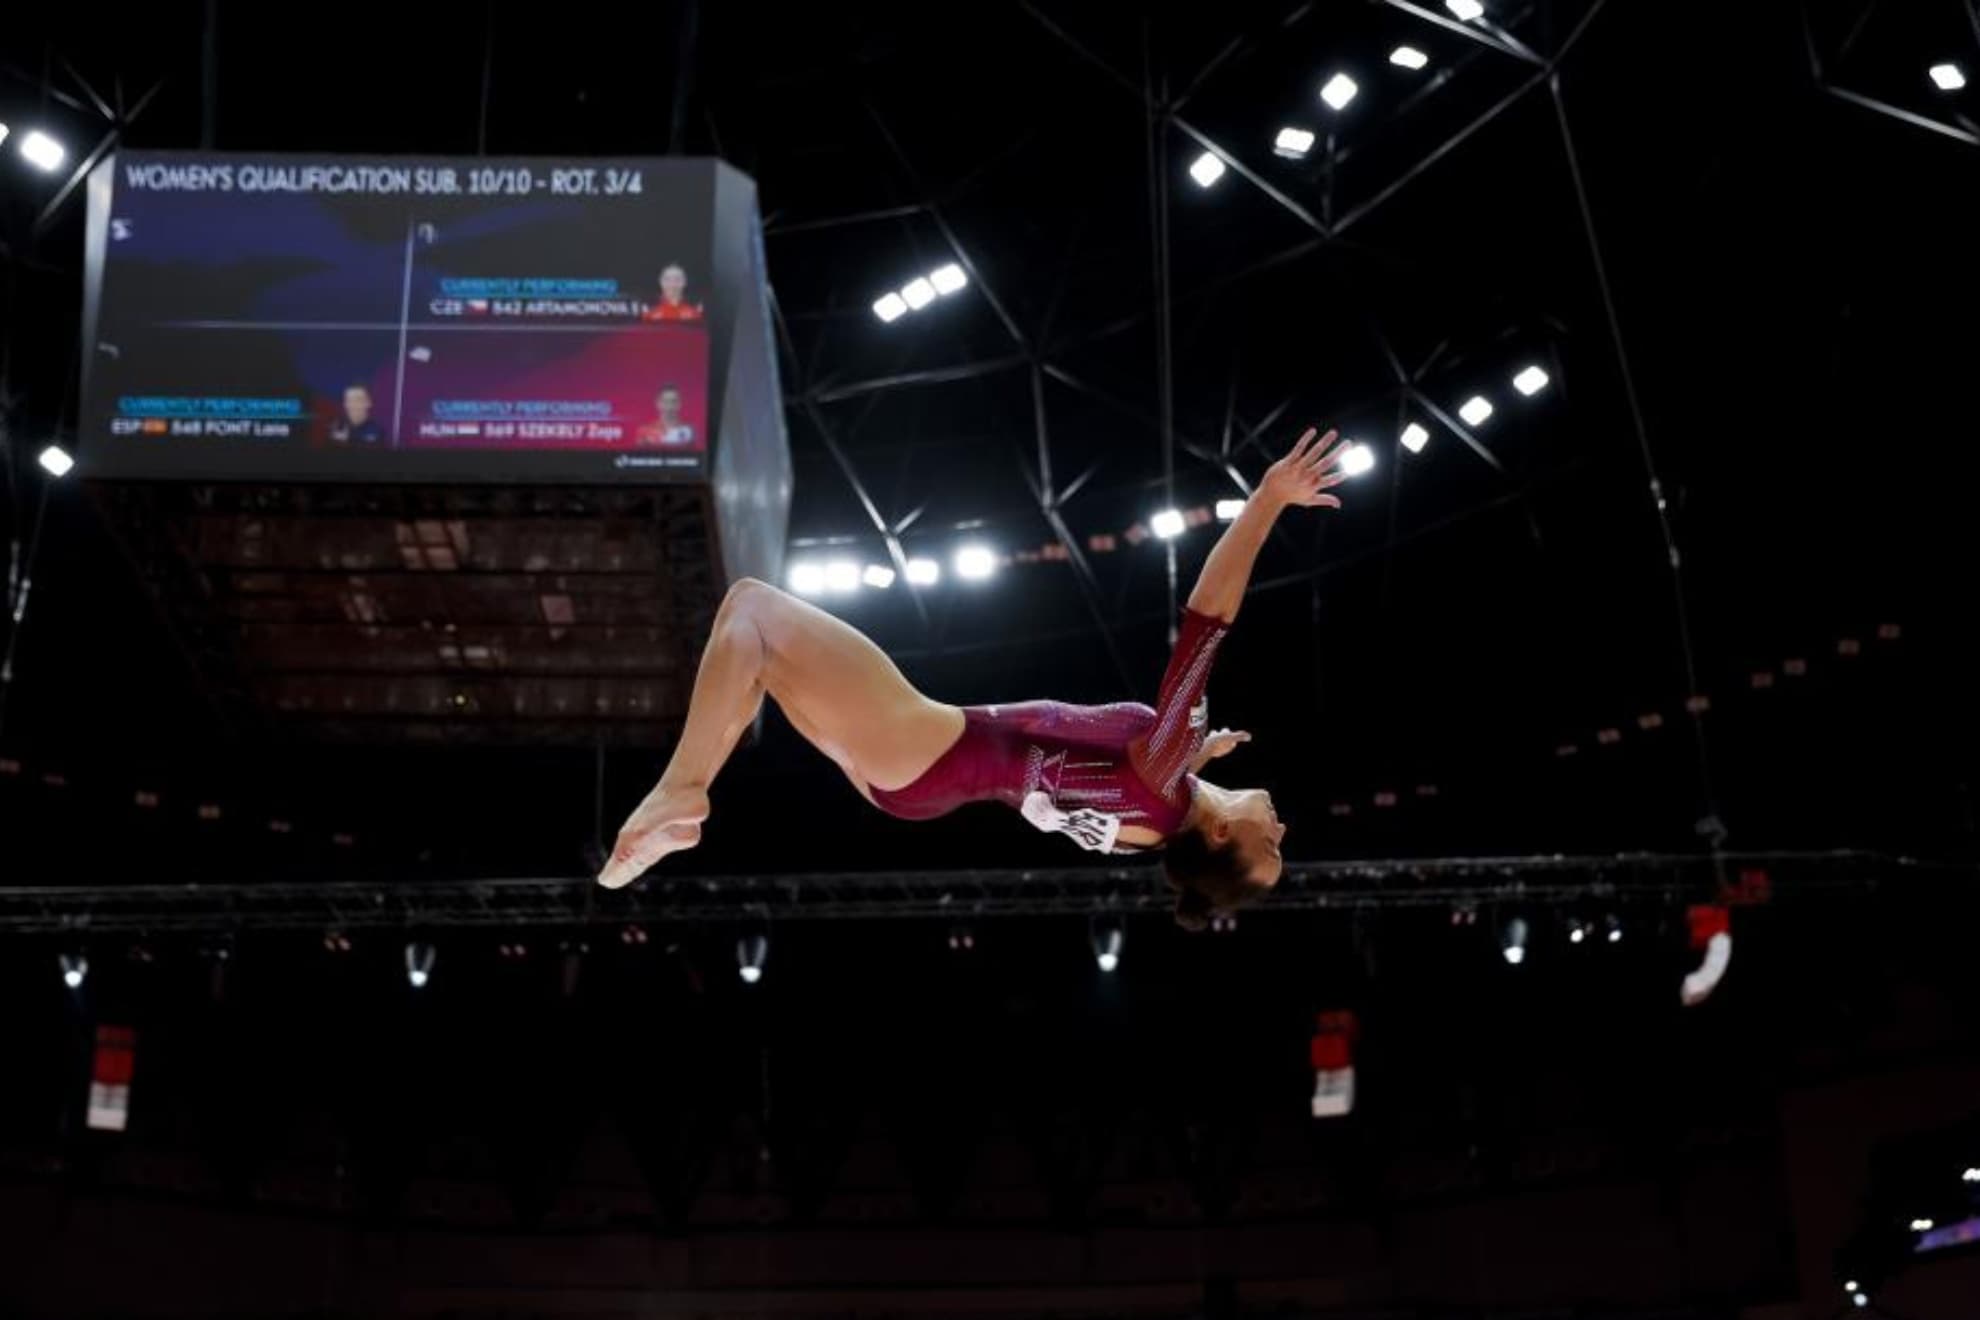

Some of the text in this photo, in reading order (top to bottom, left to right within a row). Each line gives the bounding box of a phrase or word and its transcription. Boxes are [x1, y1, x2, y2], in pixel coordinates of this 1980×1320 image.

[126, 165, 234, 191] WOMEN'S
[238, 166, 411, 192] QUALIFICATION
[415, 168, 463, 193] SUB.
[468, 169, 532, 194] 10/10
[551, 169, 599, 195] ROT.
[604, 169, 643, 195] 3/4
